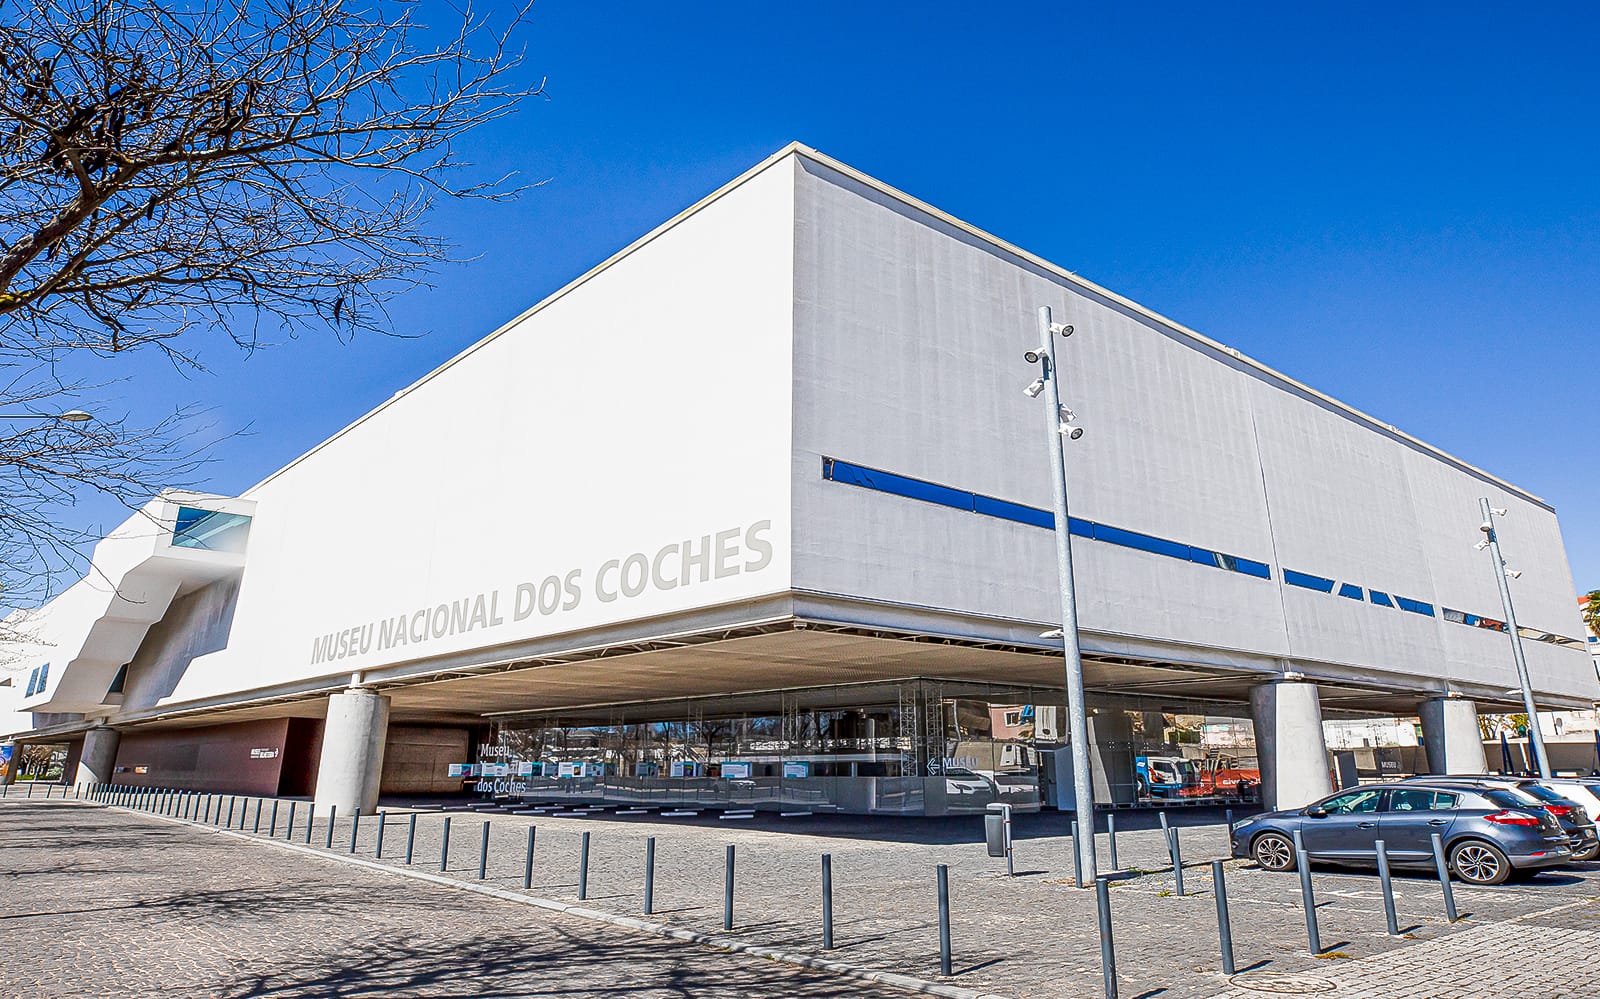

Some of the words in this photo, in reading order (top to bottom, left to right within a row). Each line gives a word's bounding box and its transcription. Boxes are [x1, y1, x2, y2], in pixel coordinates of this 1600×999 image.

[311, 622, 374, 665] MUSEU
[377, 590, 504, 651] NACIONAL
[513, 568, 582, 622] DOS
[595, 519, 773, 603] COCHES
[480, 743, 510, 757] Museu
[477, 778, 492, 793] dos
[494, 775, 526, 793] Coches
